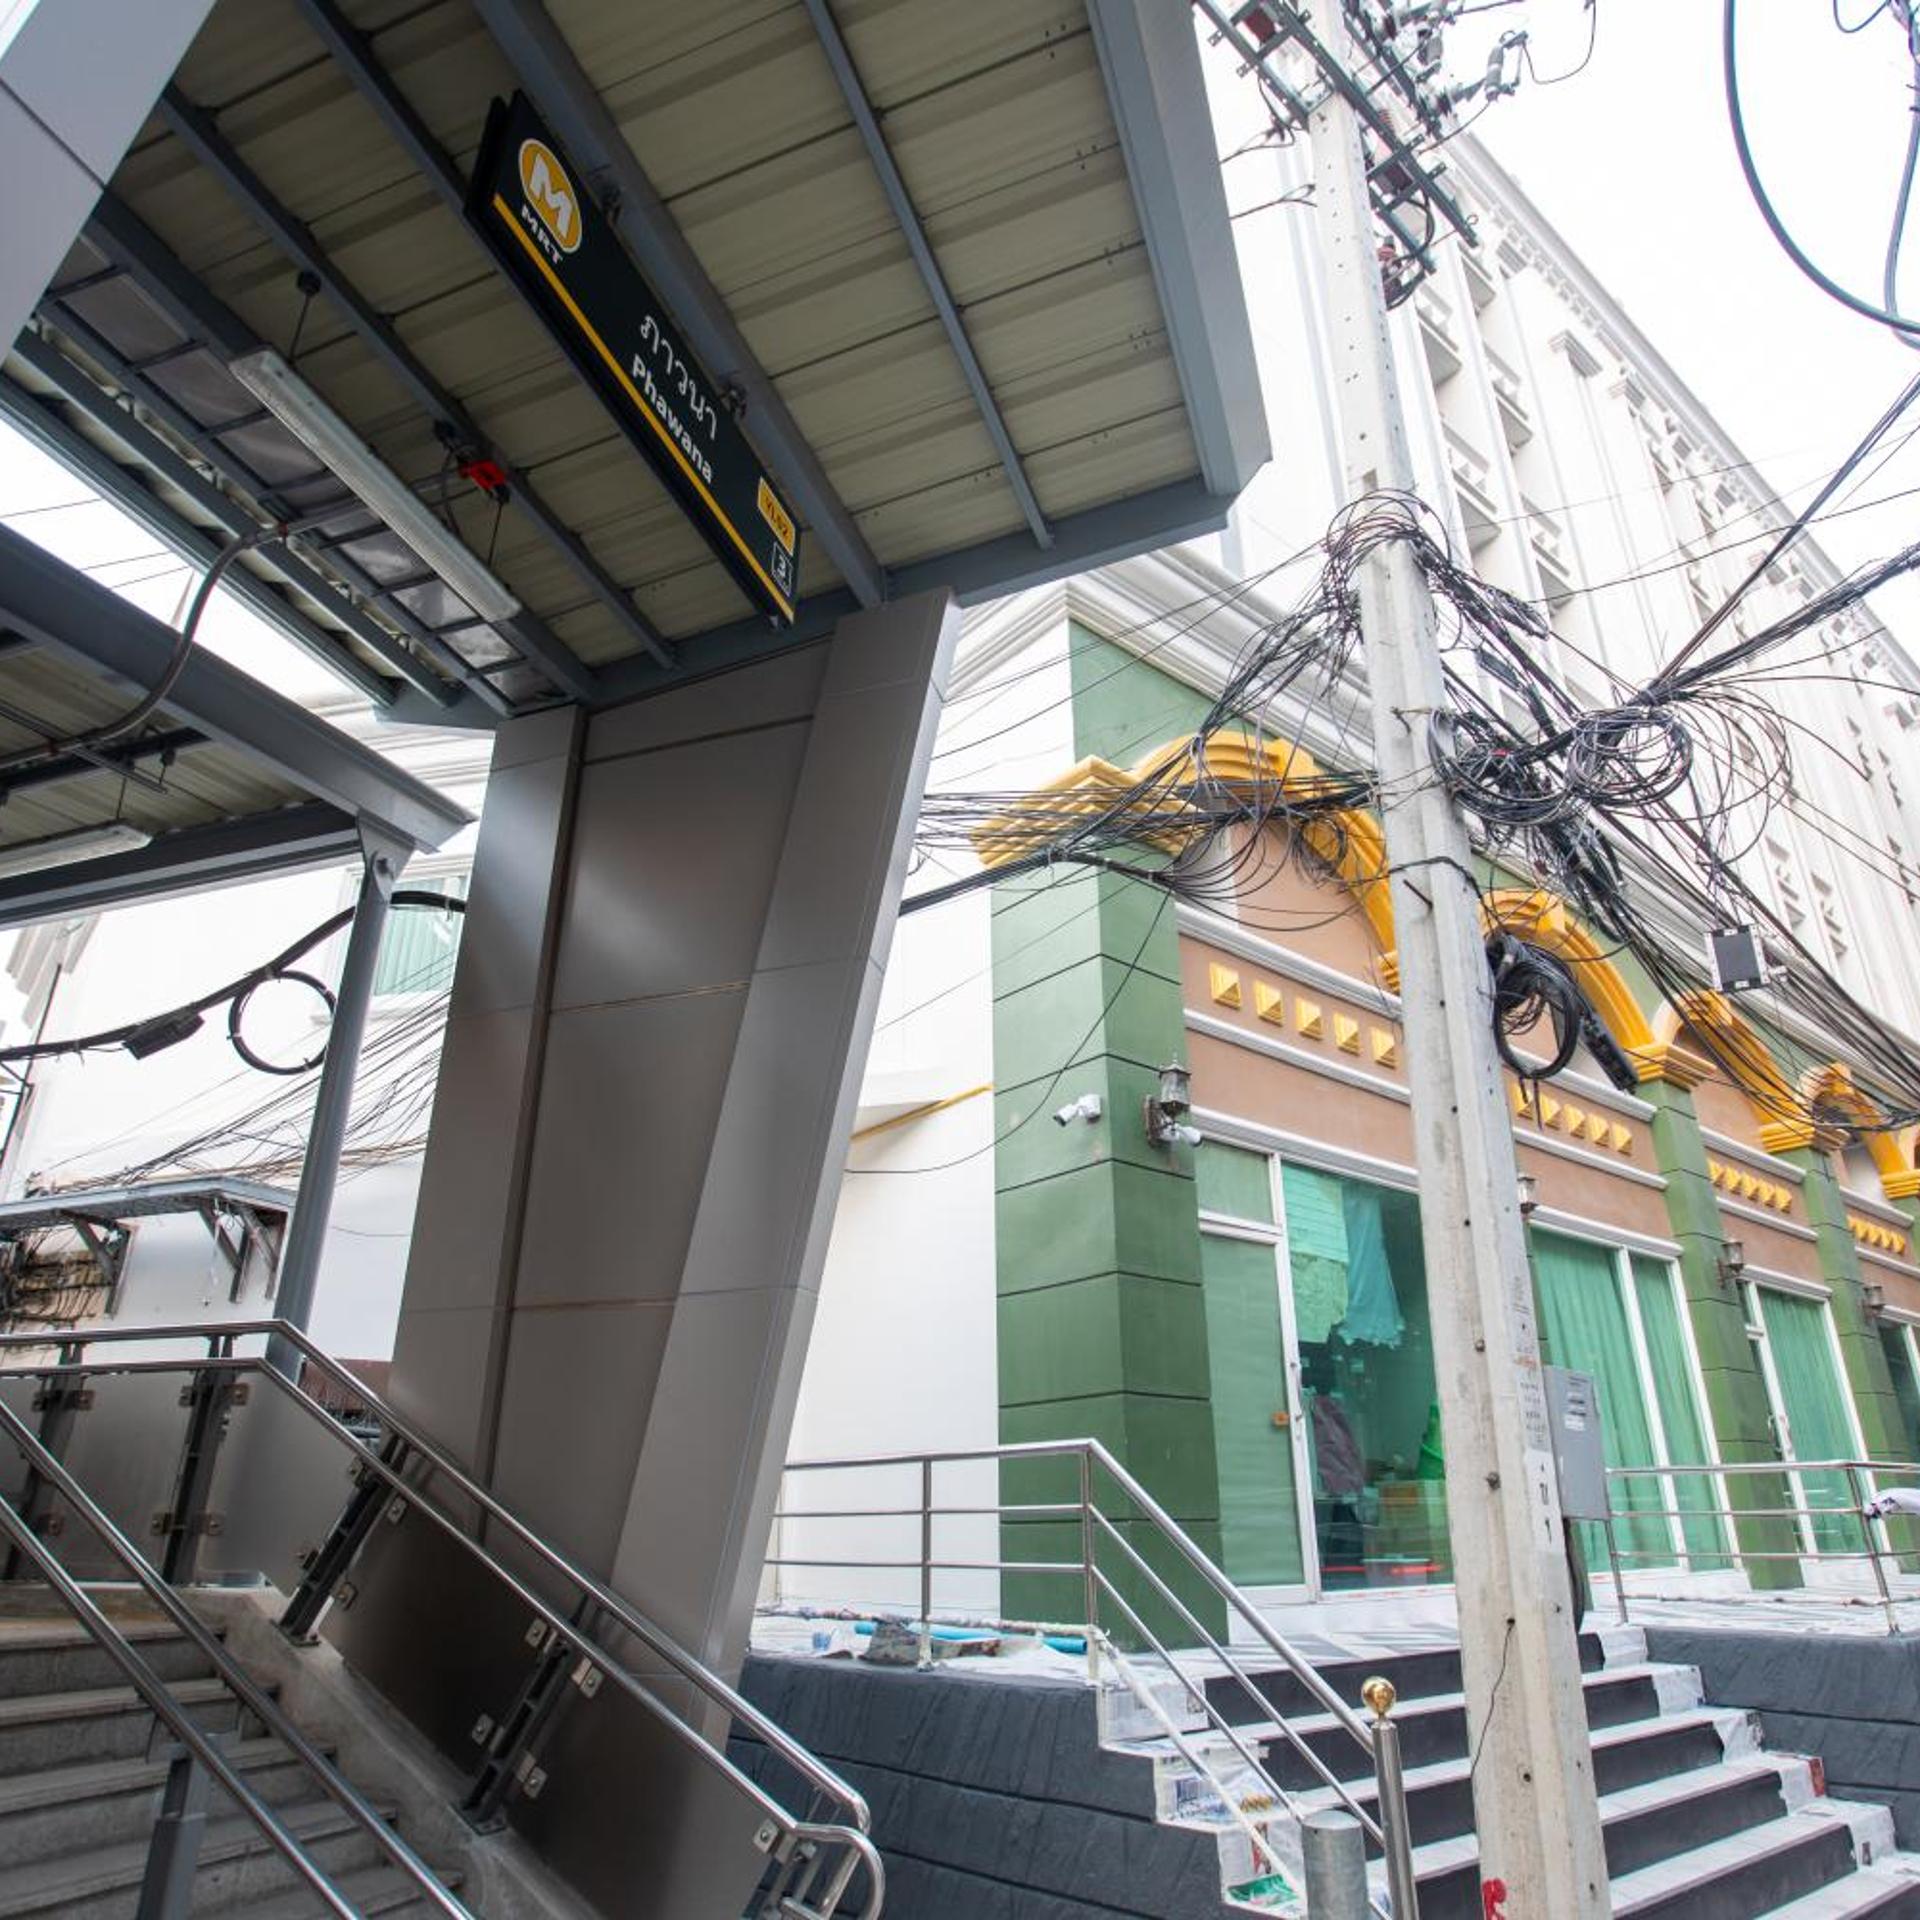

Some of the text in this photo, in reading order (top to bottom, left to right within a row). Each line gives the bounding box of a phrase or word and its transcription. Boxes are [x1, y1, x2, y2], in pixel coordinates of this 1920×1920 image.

[521, 204, 563, 264] MRT
[632, 353, 713, 484] Phawana
[640, 314, 717, 440] ภาวนา
